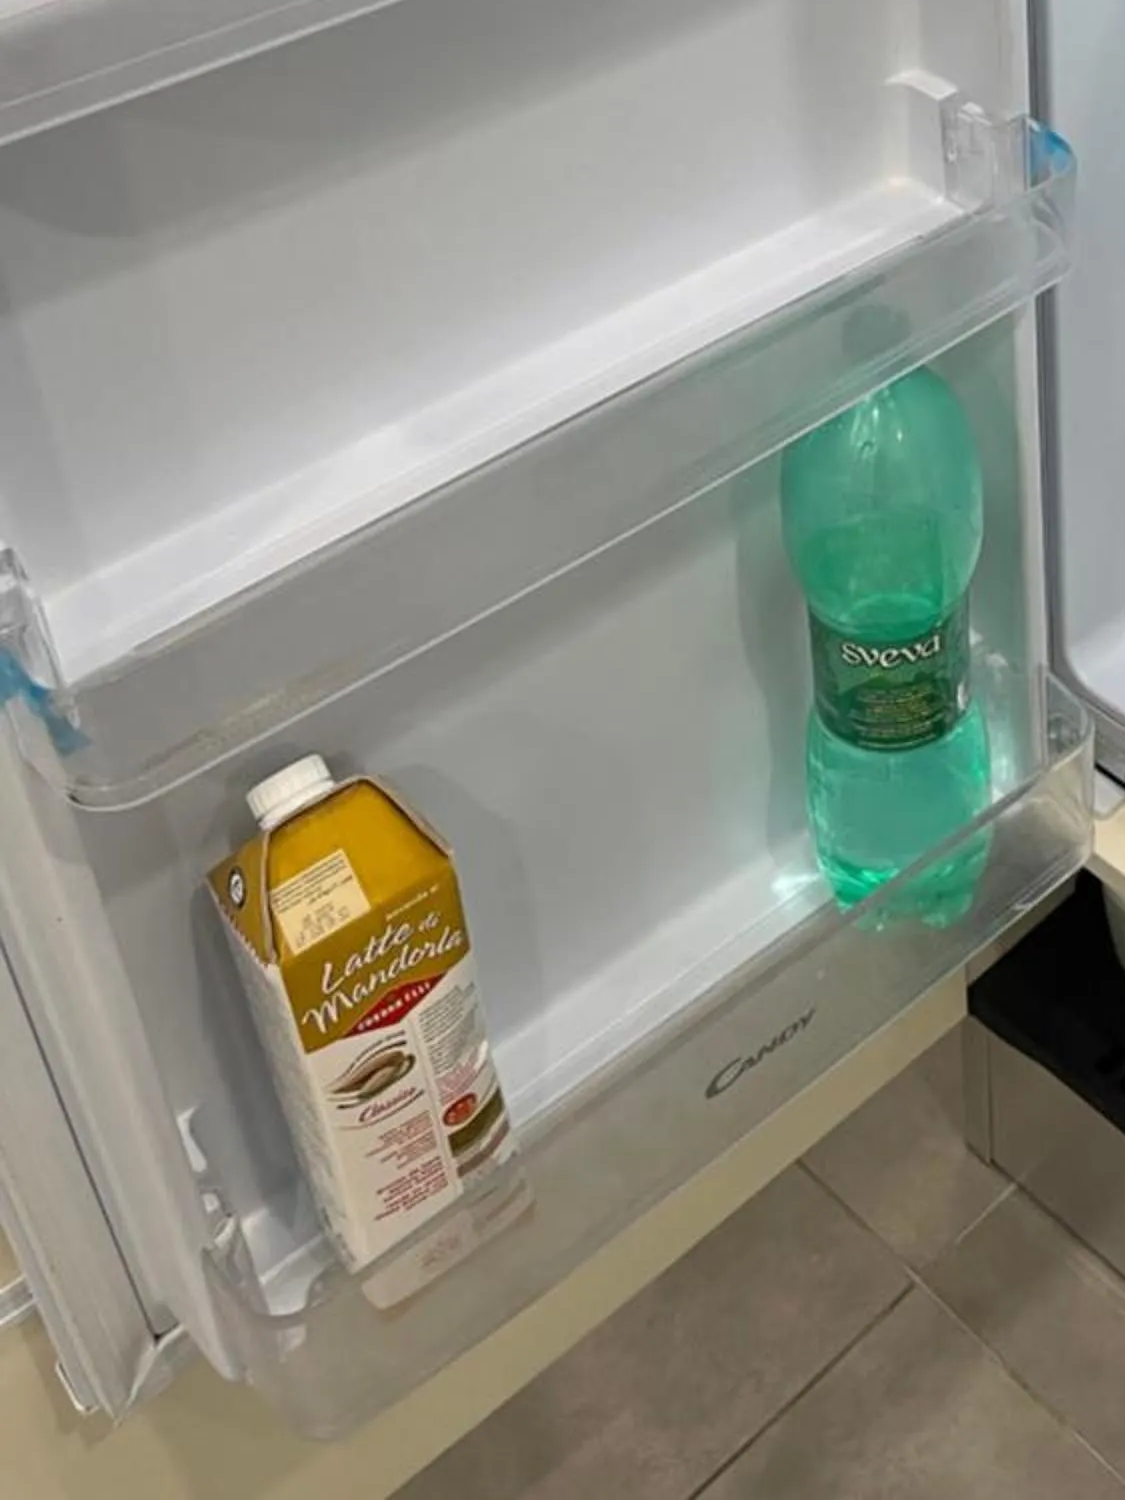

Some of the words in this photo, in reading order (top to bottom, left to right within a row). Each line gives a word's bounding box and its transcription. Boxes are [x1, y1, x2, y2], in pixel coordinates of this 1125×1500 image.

[841, 635, 942, 668] Sveva
[301, 926, 463, 1034] Mandorla
[321, 922, 415, 995] Latte
[418, 911, 441, 932] di
[705, 1007, 816, 1099] CANDY
